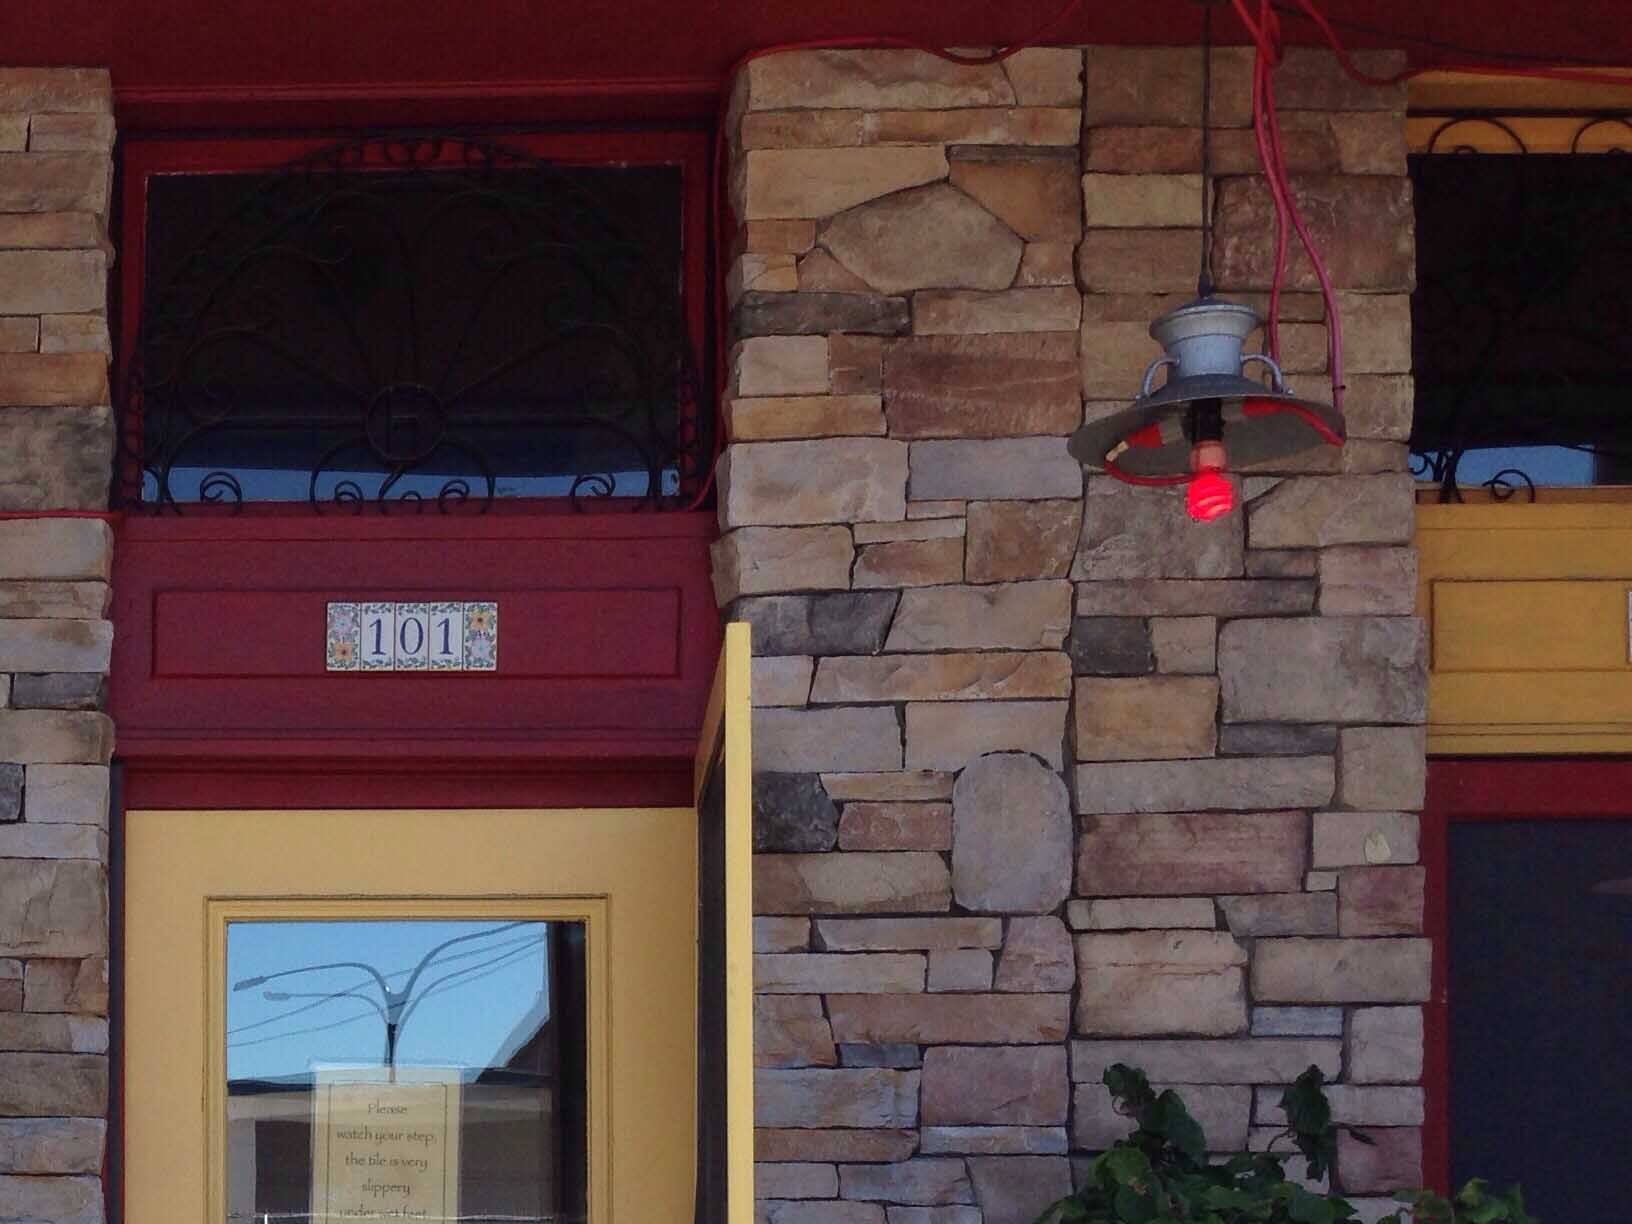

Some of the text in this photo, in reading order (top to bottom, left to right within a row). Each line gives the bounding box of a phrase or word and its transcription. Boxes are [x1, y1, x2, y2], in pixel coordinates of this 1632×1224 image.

[369, 616, 455, 656] 101
[367, 1098, 408, 1115] Please
[336, 1124, 372, 1141] watch
[375, 1129, 403, 1147] your
[345, 1151, 428, 1174] the tile is very
[361, 1177, 412, 1199] slippery
